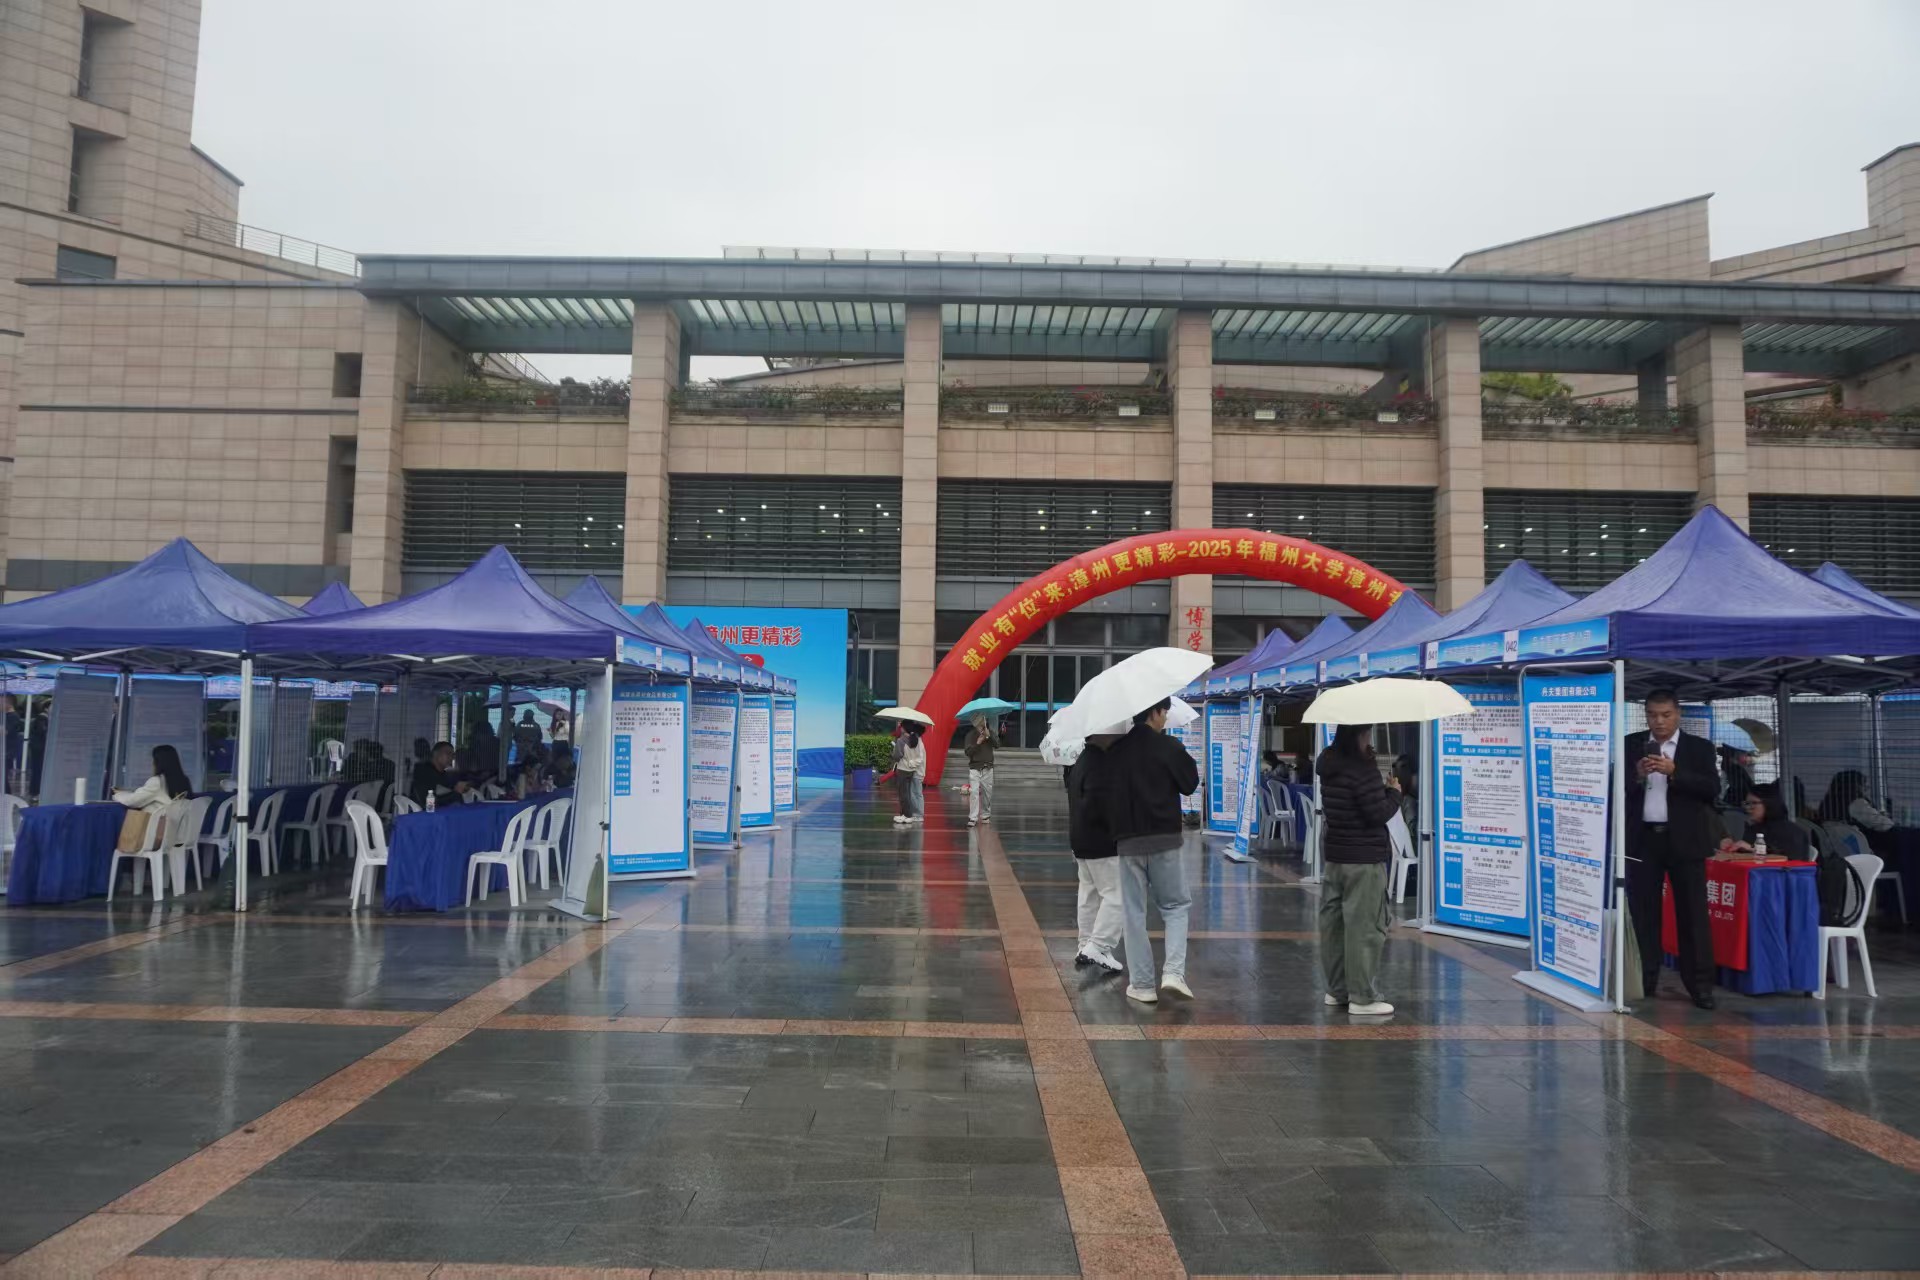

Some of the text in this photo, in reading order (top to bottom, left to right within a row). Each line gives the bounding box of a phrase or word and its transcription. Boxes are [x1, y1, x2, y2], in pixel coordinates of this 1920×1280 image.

[1185, 606, 1205, 652] 博学
[1505, 640, 1518, 653] 042
[1427, 650, 1438, 661] 041
